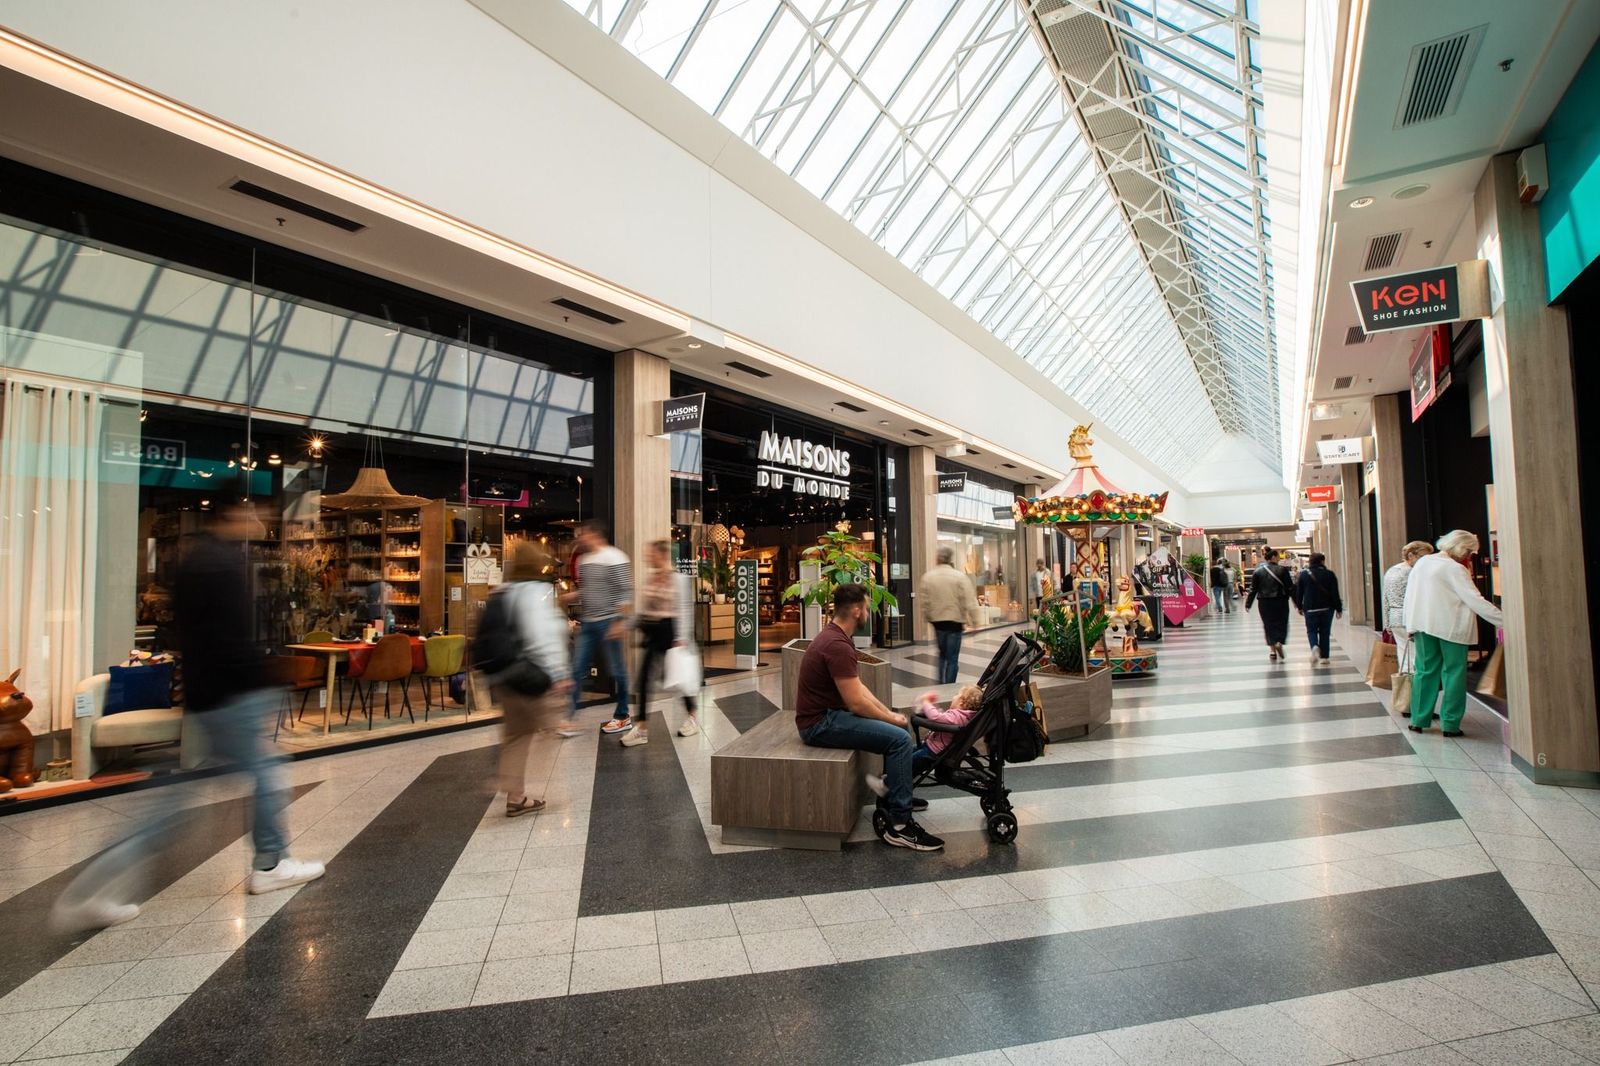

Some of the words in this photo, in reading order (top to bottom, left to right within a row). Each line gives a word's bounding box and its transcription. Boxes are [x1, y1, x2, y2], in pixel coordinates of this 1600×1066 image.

[1373, 311, 1398, 321] SHOE
[1403, 304, 1447, 317] FASHION
[666, 405, 698, 418] MAISONS
[758, 430, 850, 477] MAISONS
[757, 471, 783, 489] DU
[793, 477, 850, 500] MONDE
[737, 565, 748, 615] GOOD
[1537, 752, 1547, 766] 6
